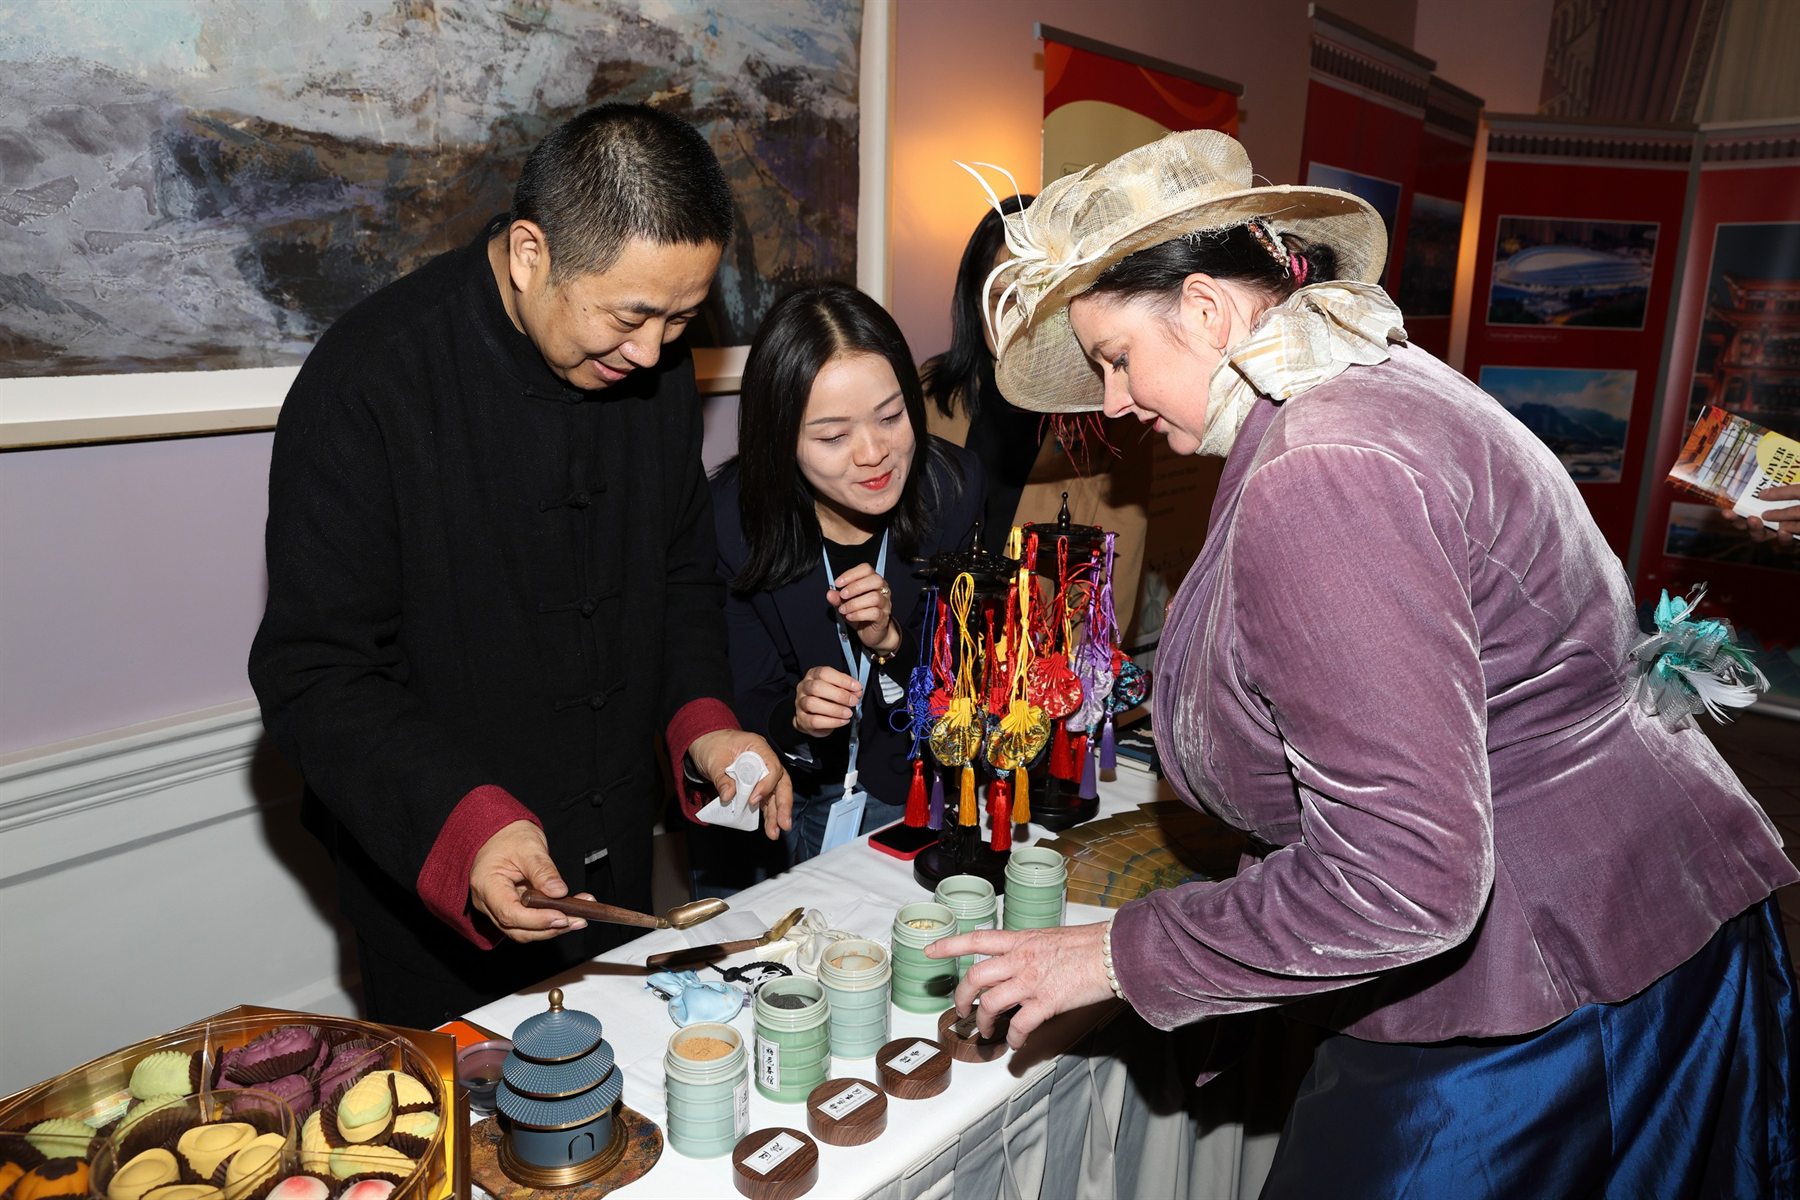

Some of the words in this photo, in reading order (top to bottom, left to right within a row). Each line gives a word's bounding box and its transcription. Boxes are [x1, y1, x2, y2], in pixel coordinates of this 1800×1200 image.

[1752, 447, 1786, 499] DISCOVER
[1770, 470, 1785, 488] THE
[1780, 451, 1795, 469] NEW
